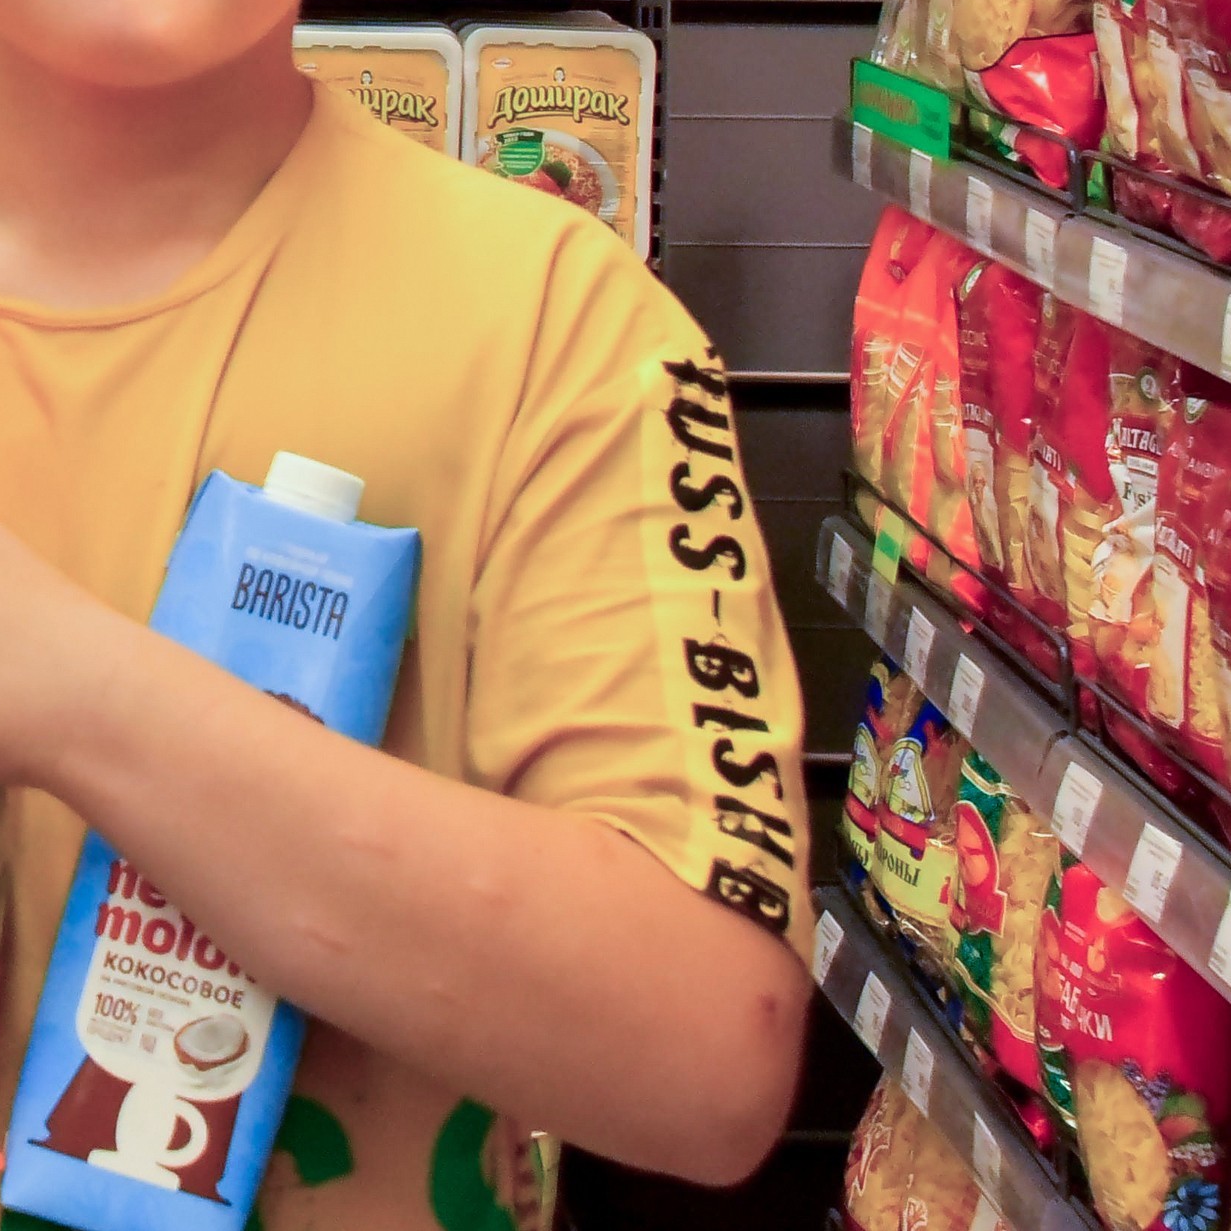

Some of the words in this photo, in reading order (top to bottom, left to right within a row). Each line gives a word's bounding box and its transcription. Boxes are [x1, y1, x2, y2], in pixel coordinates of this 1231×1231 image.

[487, 84, 630, 129] Доширак
[231, 562, 349, 641] BARISTA
[95, 901, 257, 985] molo
[94, 992, 141, 1026] 100%
[103, 949, 245, 1010] КОКОСОВОЕ
